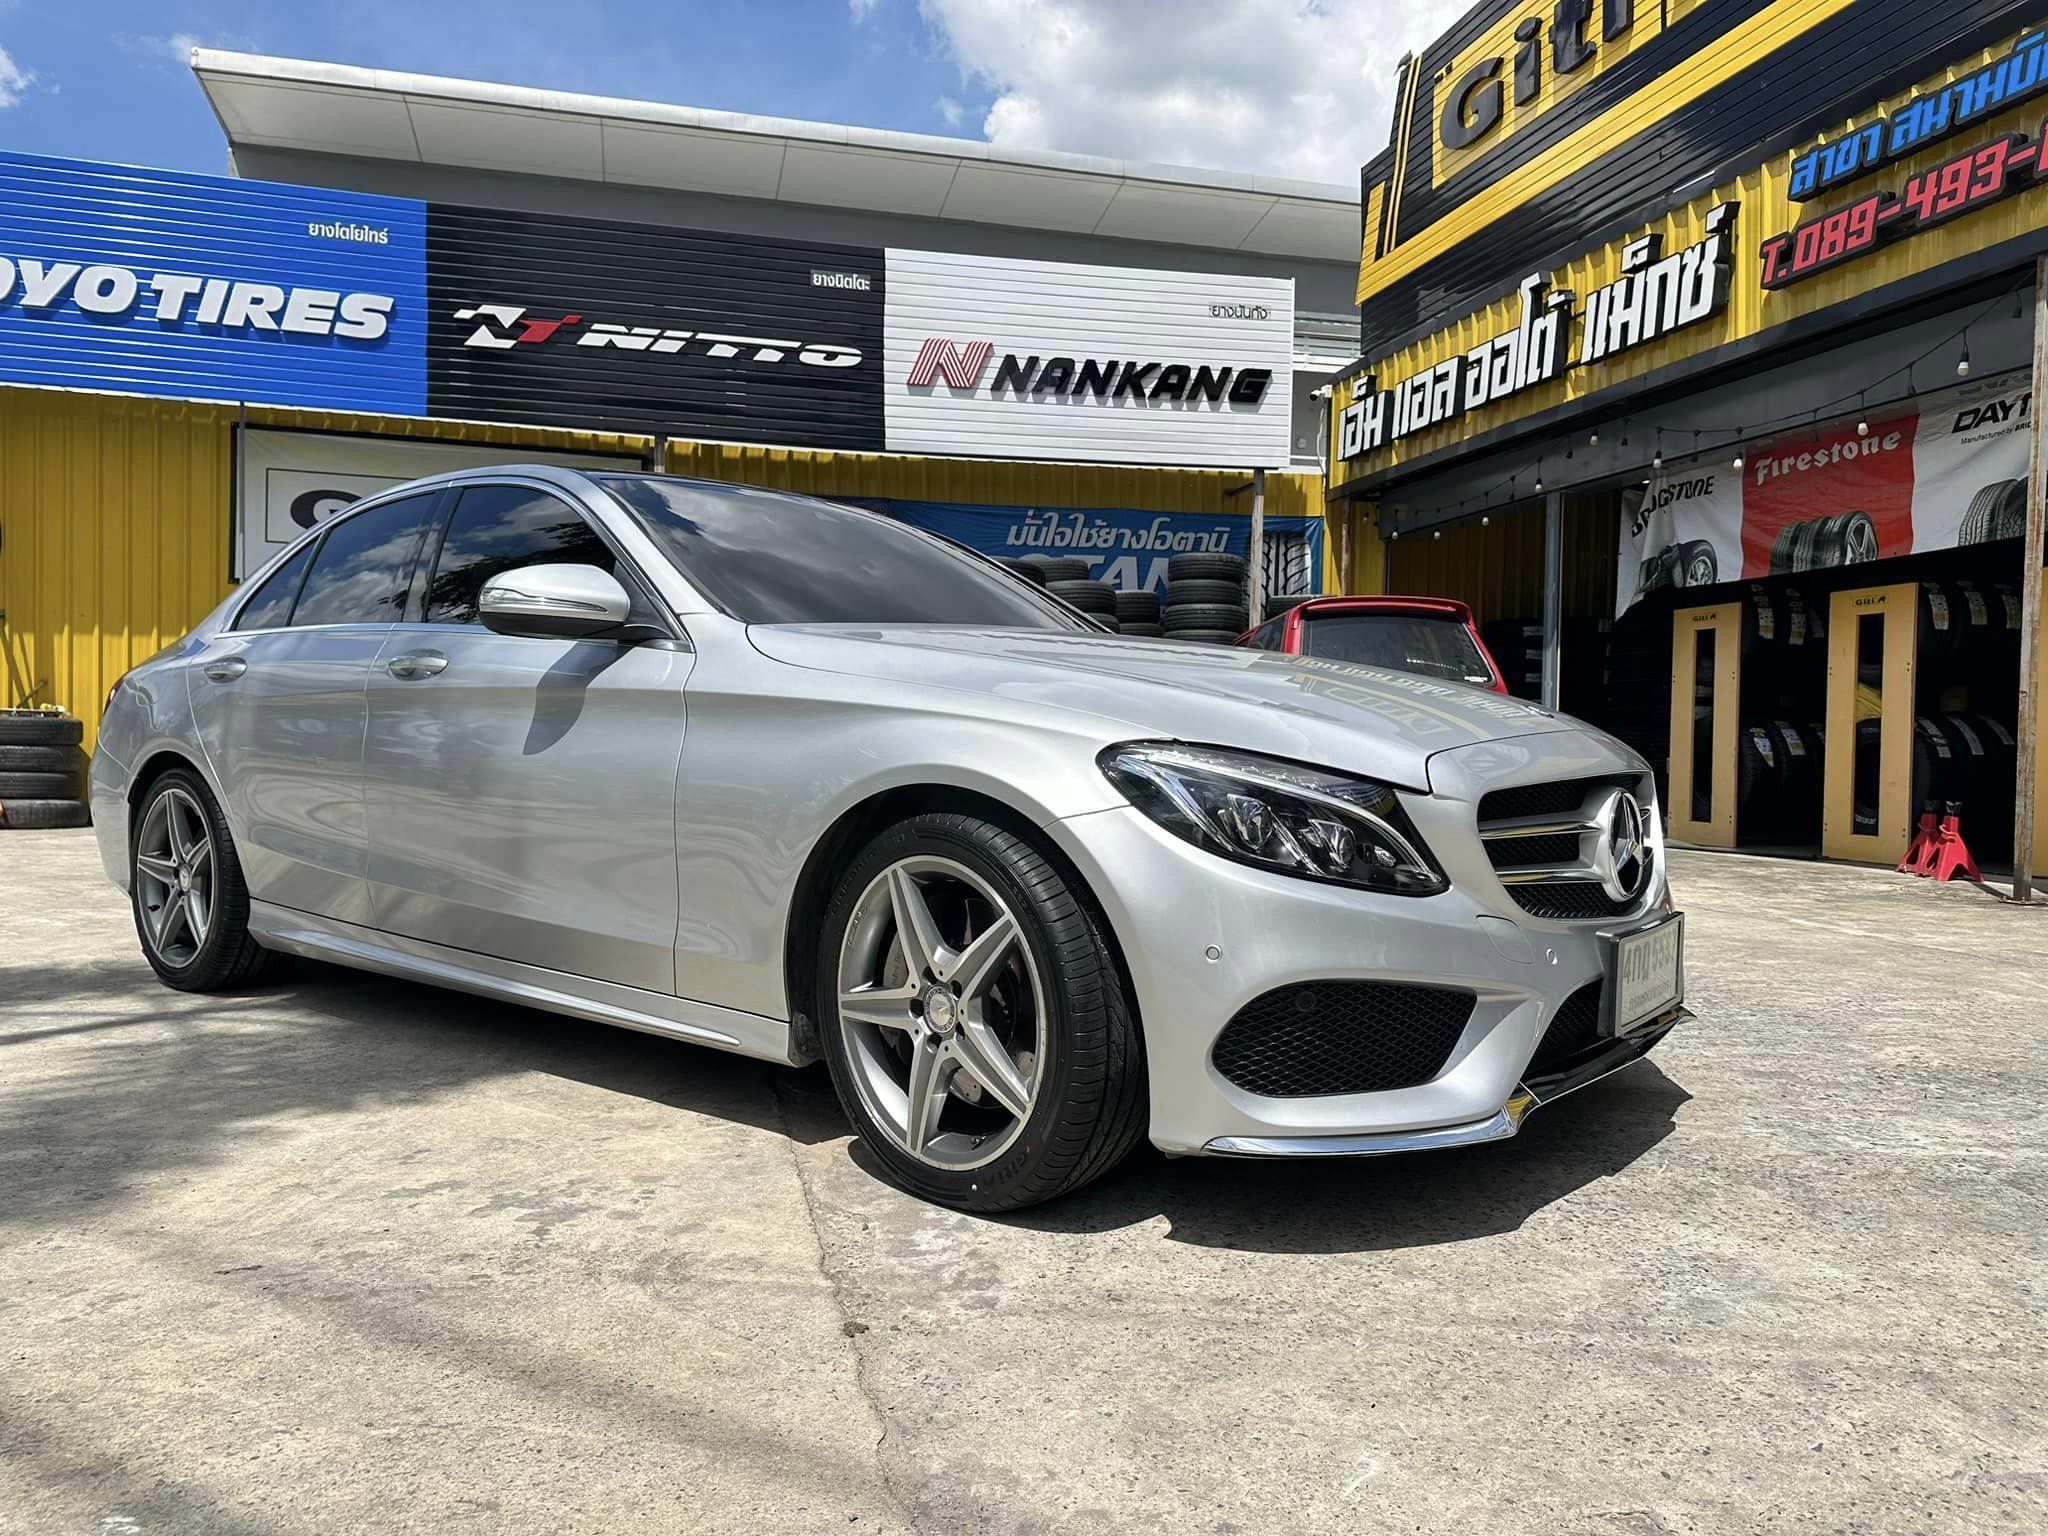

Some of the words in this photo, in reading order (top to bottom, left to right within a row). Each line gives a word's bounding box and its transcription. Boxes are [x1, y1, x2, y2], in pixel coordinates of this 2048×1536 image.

[1790, 124, 1882, 196] สาขา
[1890, 31, 2048, 151] สนามบิ
[1762, 122, 2048, 284] T.089-493-
[151, 273, 395, 340] TIRES
[1337, 376, 1386, 462] เอ็ม
[1391, 356, 1462, 441] แอล
[1464, 271, 1574, 412] ออโต้
[1580, 203, 1739, 366] แม็กซ์
[576, 323, 864, 368] NITTO
[990, 353, 1273, 405] NANKANG
[1754, 431, 1902, 487] Firestone
[1006, 508, 1231, 553] มั่นใจใช้ยางโอตานิ
[1855, 597, 1875, 606] Giti
